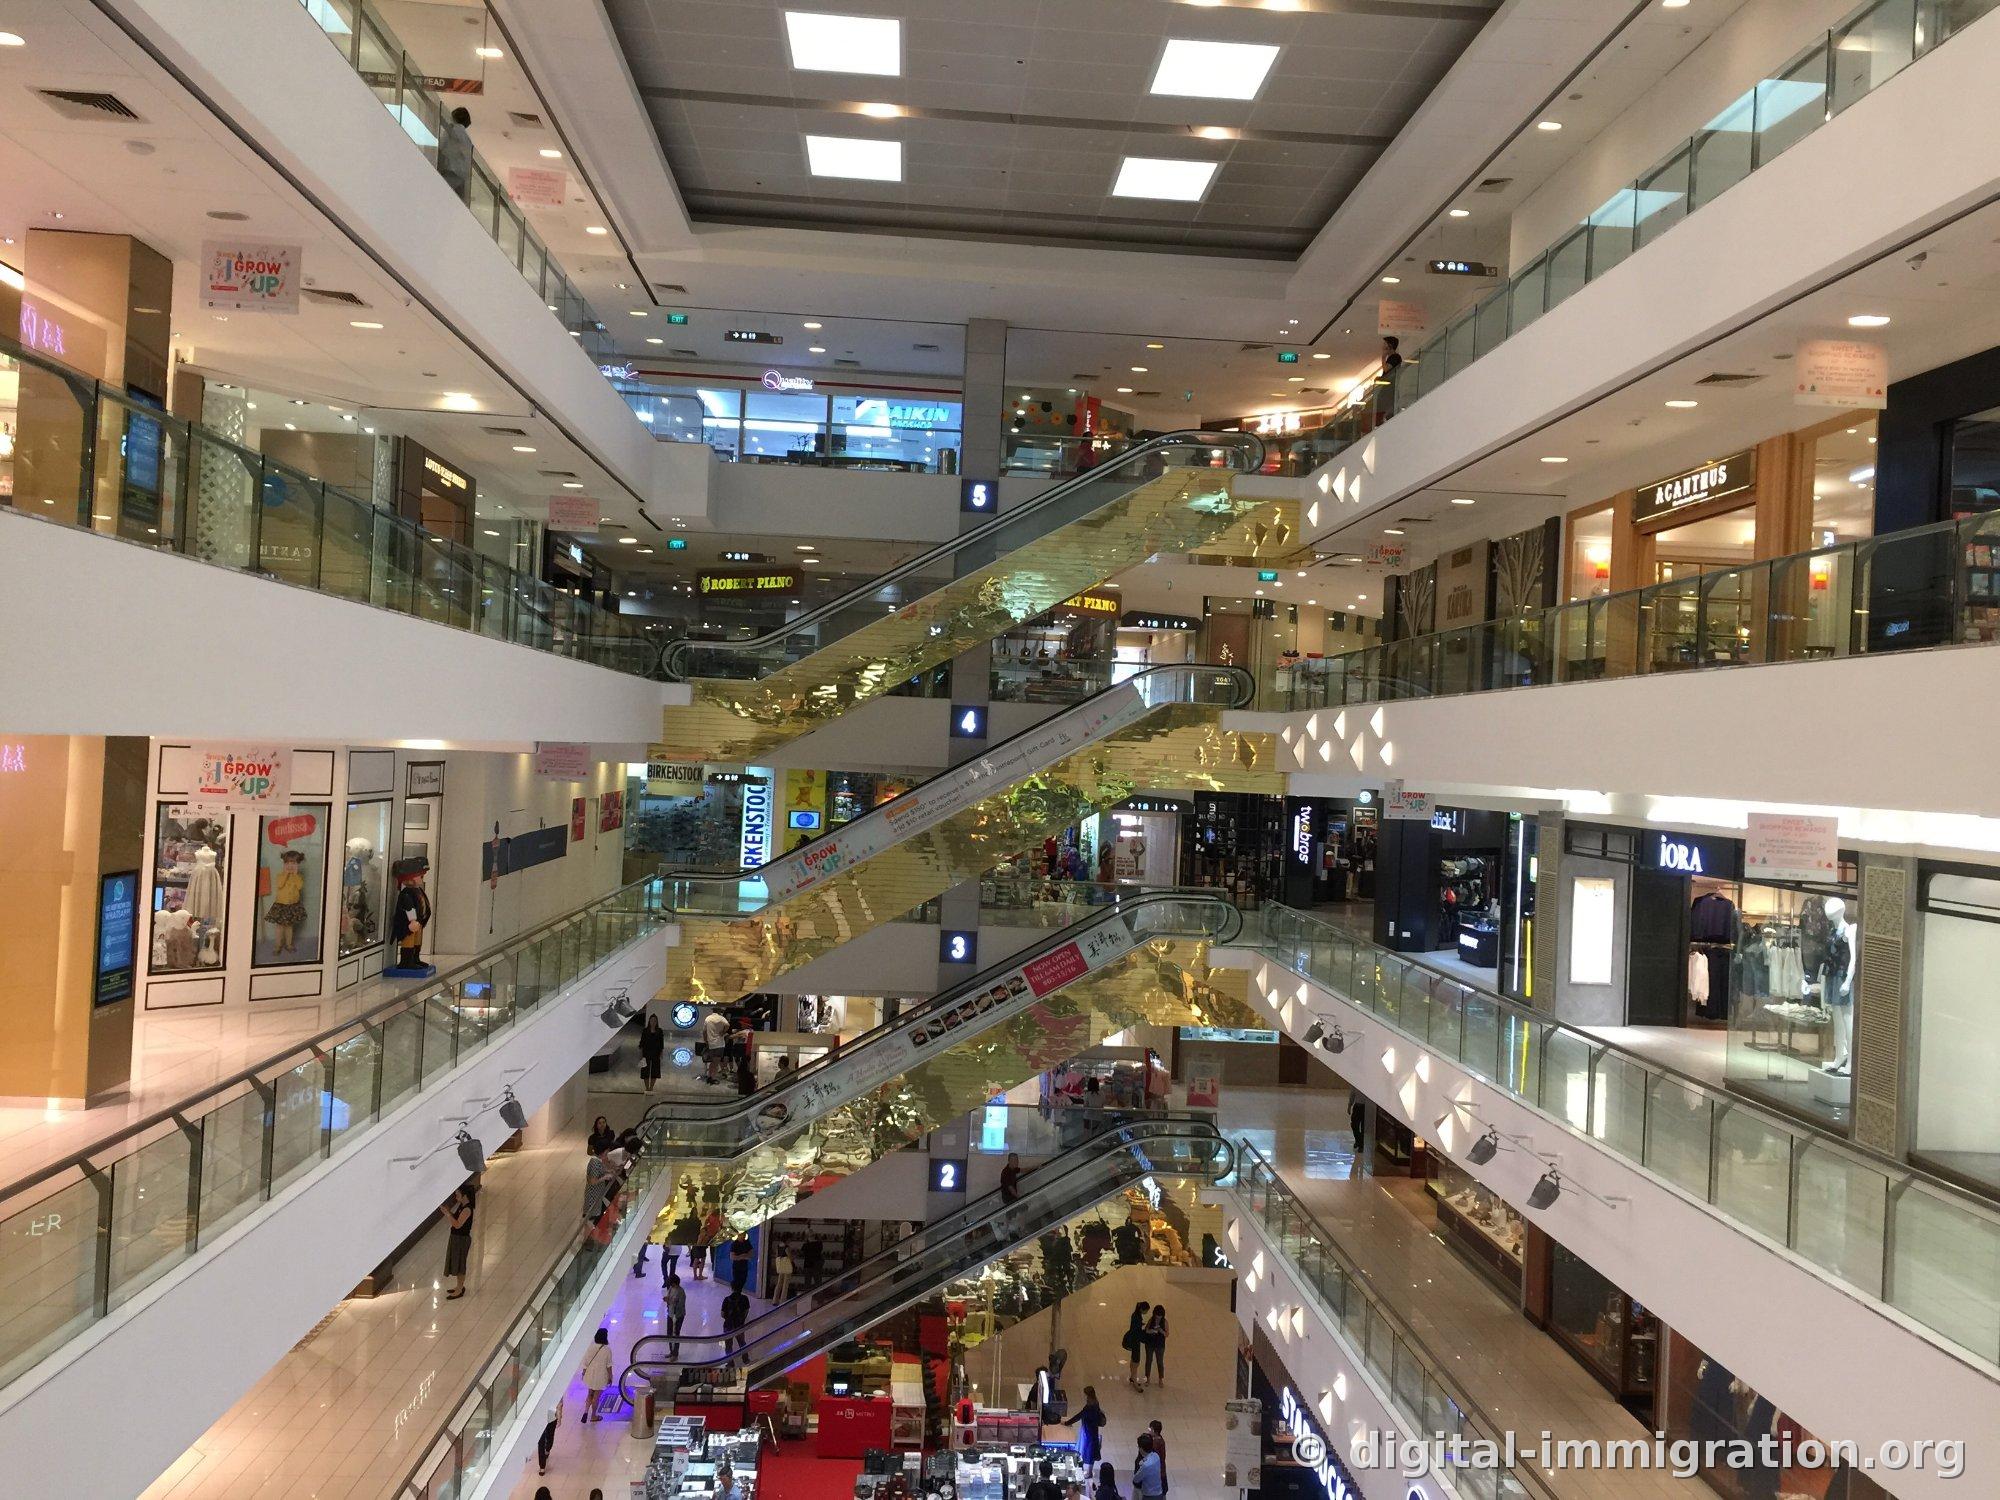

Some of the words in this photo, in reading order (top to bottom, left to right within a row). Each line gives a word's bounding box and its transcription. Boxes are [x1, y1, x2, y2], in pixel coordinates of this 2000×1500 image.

[234, 260, 281, 275] GROW
[249, 276, 280, 294] UP
[671, 315, 684, 323] EXIT
[890, 405, 950, 422] AIKIN
[1655, 465, 1728, 505] ACANTHUS
[972, 484, 987, 507] 5
[1379, 548, 1402, 556] GROW
[711, 578, 755, 590] ROBERT
[756, 576, 794, 589] PIANO
[1084, 596, 1117, 612] PIANO
[961, 710, 976, 733] 4
[224, 762, 272, 777] GROW
[647, 763, 704, 782] BIRKENSTOCK
[239, 777, 270, 795] UP
[1402, 791, 1426, 799] GROW
[804, 842, 838, 867] GROW
[1659, 835, 1704, 873] iORA
[822, 853, 842, 874] UP
[951, 935, 966, 960] 3
[1032, 959, 1051, 973] NOW
[1051, 948, 1072, 963] OPEN
[1059, 953, 1081, 969] DAILY
[940, 1164, 955, 1187] 2
